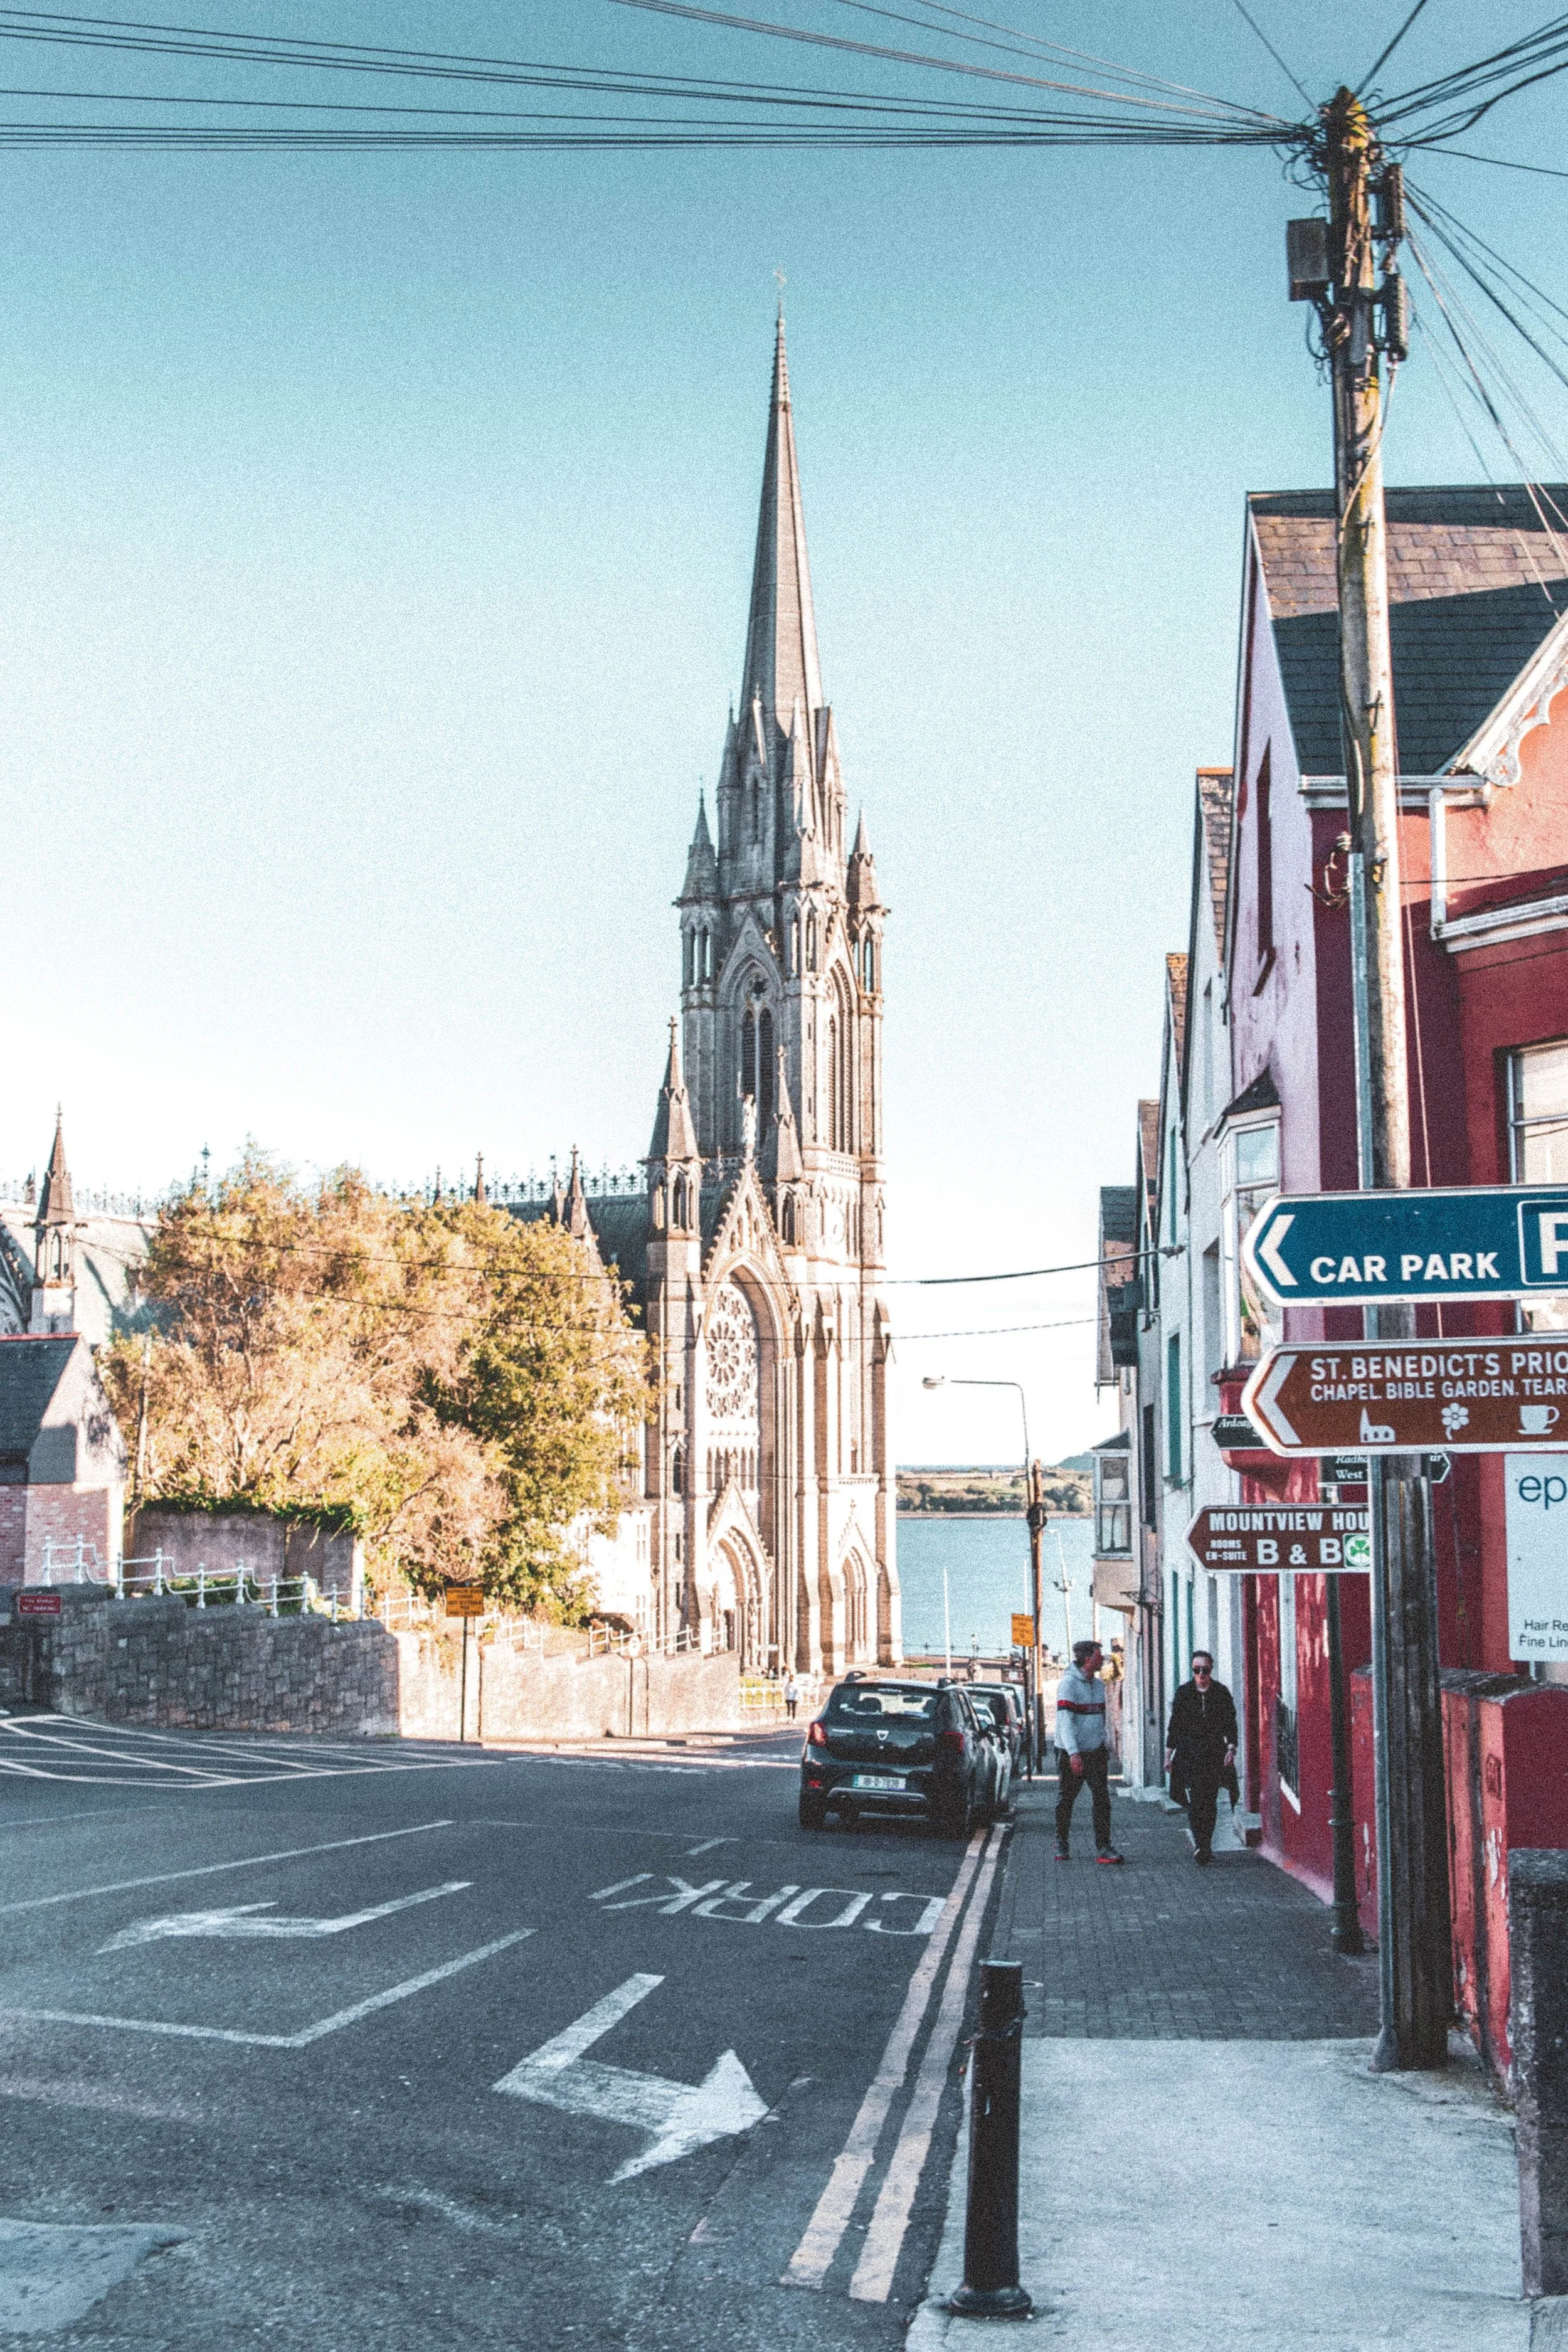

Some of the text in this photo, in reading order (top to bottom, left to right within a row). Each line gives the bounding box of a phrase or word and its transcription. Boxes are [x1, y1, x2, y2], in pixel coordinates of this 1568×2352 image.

[1310, 1252, 1500, 1283] CAR PARK
[1512, 1350, 1568, 1375] PRIO
[1386, 1381, 1436, 1399] BIBLE
[1336, 1469, 1364, 1479] West
[1518, 1476, 1567, 1510] ep
[1209, 1512, 1323, 1531] MOUNTVIEW
[1205, 1551, 1248, 1561] EN-SUITE
[1257, 1538, 1342, 1565] B & B
[1524, 1619, 1568, 1631] Hair Re
[1520, 1634, 1568, 1648] Fine Lin
[600, 1876, 947, 1936] CORK
